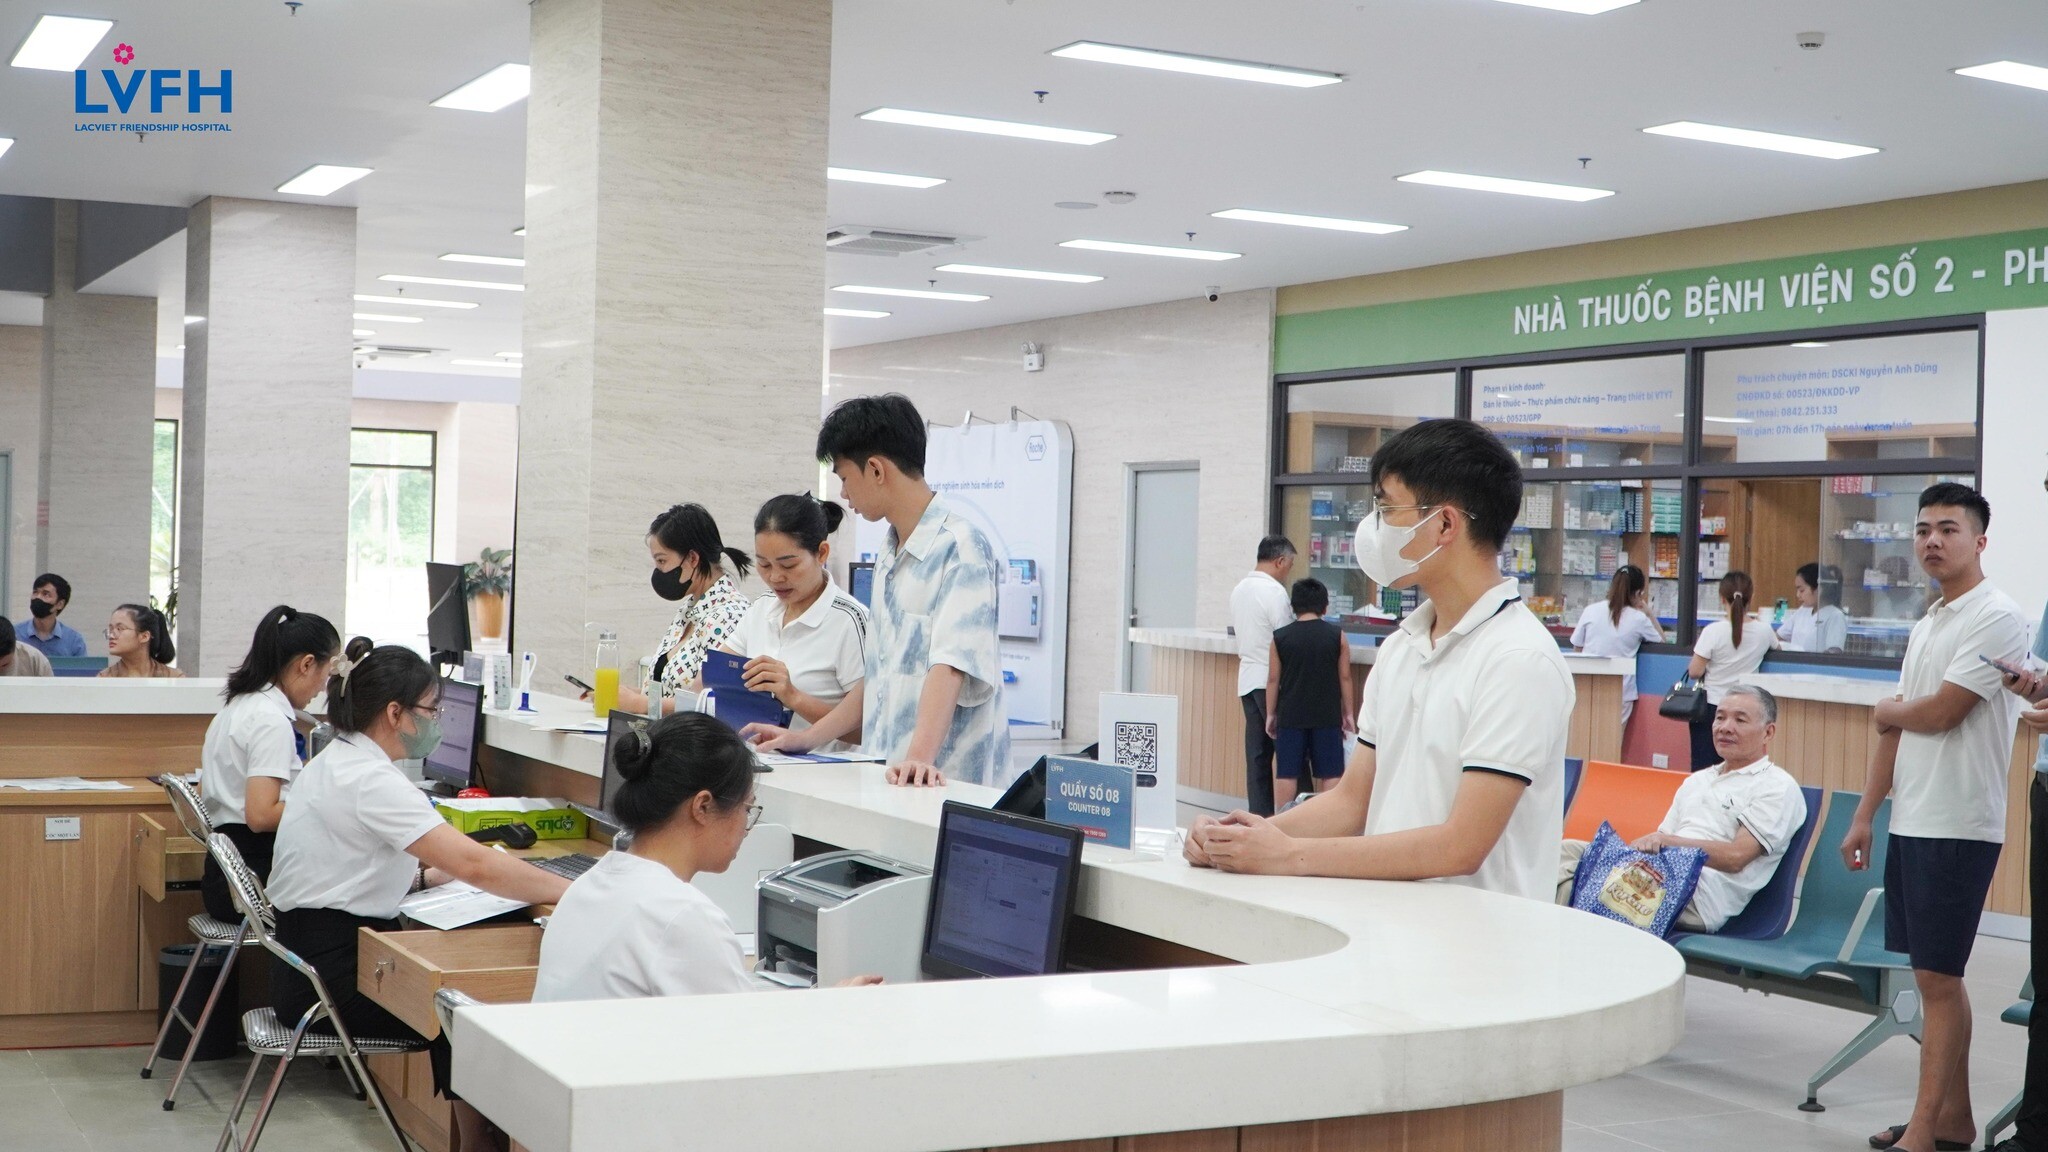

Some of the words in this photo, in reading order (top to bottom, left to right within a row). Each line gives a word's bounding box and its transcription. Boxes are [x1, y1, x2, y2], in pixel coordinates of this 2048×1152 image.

[1514, 295, 1567, 335] NHÀ
[1578, 278, 1672, 329] THUỐC
[1685, 276, 1765, 325] BỆNH
[1780, 263, 1853, 314] VIỆN
[1869, 247, 1918, 300] SỐ
[1934, 256, 1955, 293] 2
[1777, 371, 1807, 382] chuyên
[1809, 369, 1829, 379] môn:
[1832, 368, 1857, 378] DSCKI
[1860, 364, 1893, 378] Nguyễn
[1894, 364, 1912, 374] Anh
[1502, 384, 1508, 392] vi
[1509, 384, 1523, 392] kinh
[1781, 405, 1838, 416] 0842.251.333
[1776, 425, 1791, 434] 07h
[1811, 423, 1825, 433] 17h
[1060, 780, 1088, 799] QUẦY
[1089, 783, 1104, 801] SỐ
[1105, 788, 1120, 804] 08
[1068, 802, 1100, 815] COUNTER
[1101, 807, 1111, 817] 08
[536, 816, 563, 834] plus
